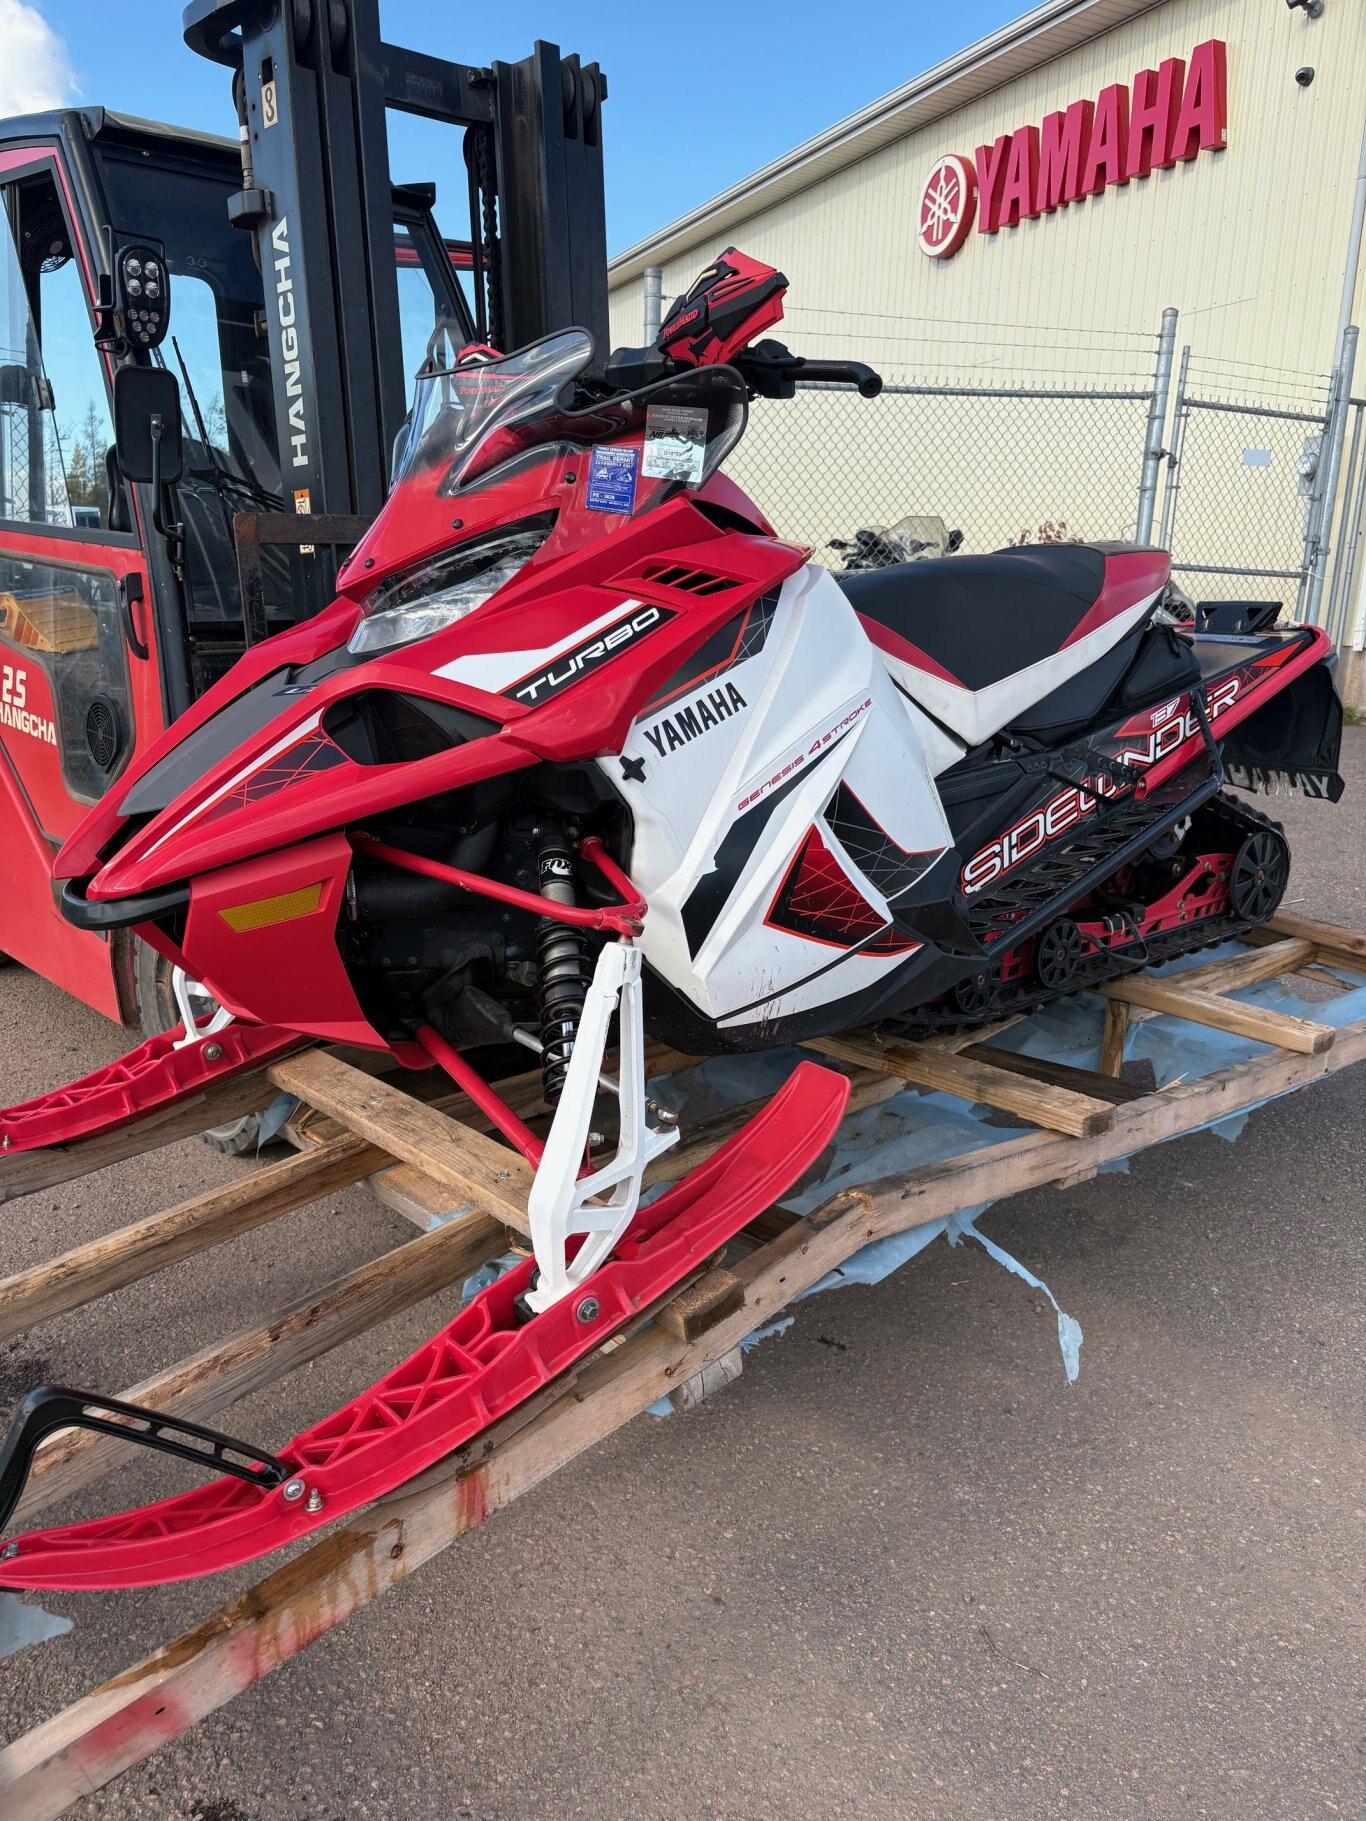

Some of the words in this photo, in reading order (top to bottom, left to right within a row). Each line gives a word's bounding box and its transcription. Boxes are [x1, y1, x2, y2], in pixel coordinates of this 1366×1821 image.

[975, 39, 1227, 234] YAMAHA
[272, 216, 309, 467] HANGCHA
[516, 607, 660, 699] TURBO
[2, 664, 26, 708] 25
[1150, 697, 1180, 728] 137
[643, 682, 748, 757] YAMAHA
[738, 755, 804, 811] GENESIS
[541, 858, 573, 876] FOX
